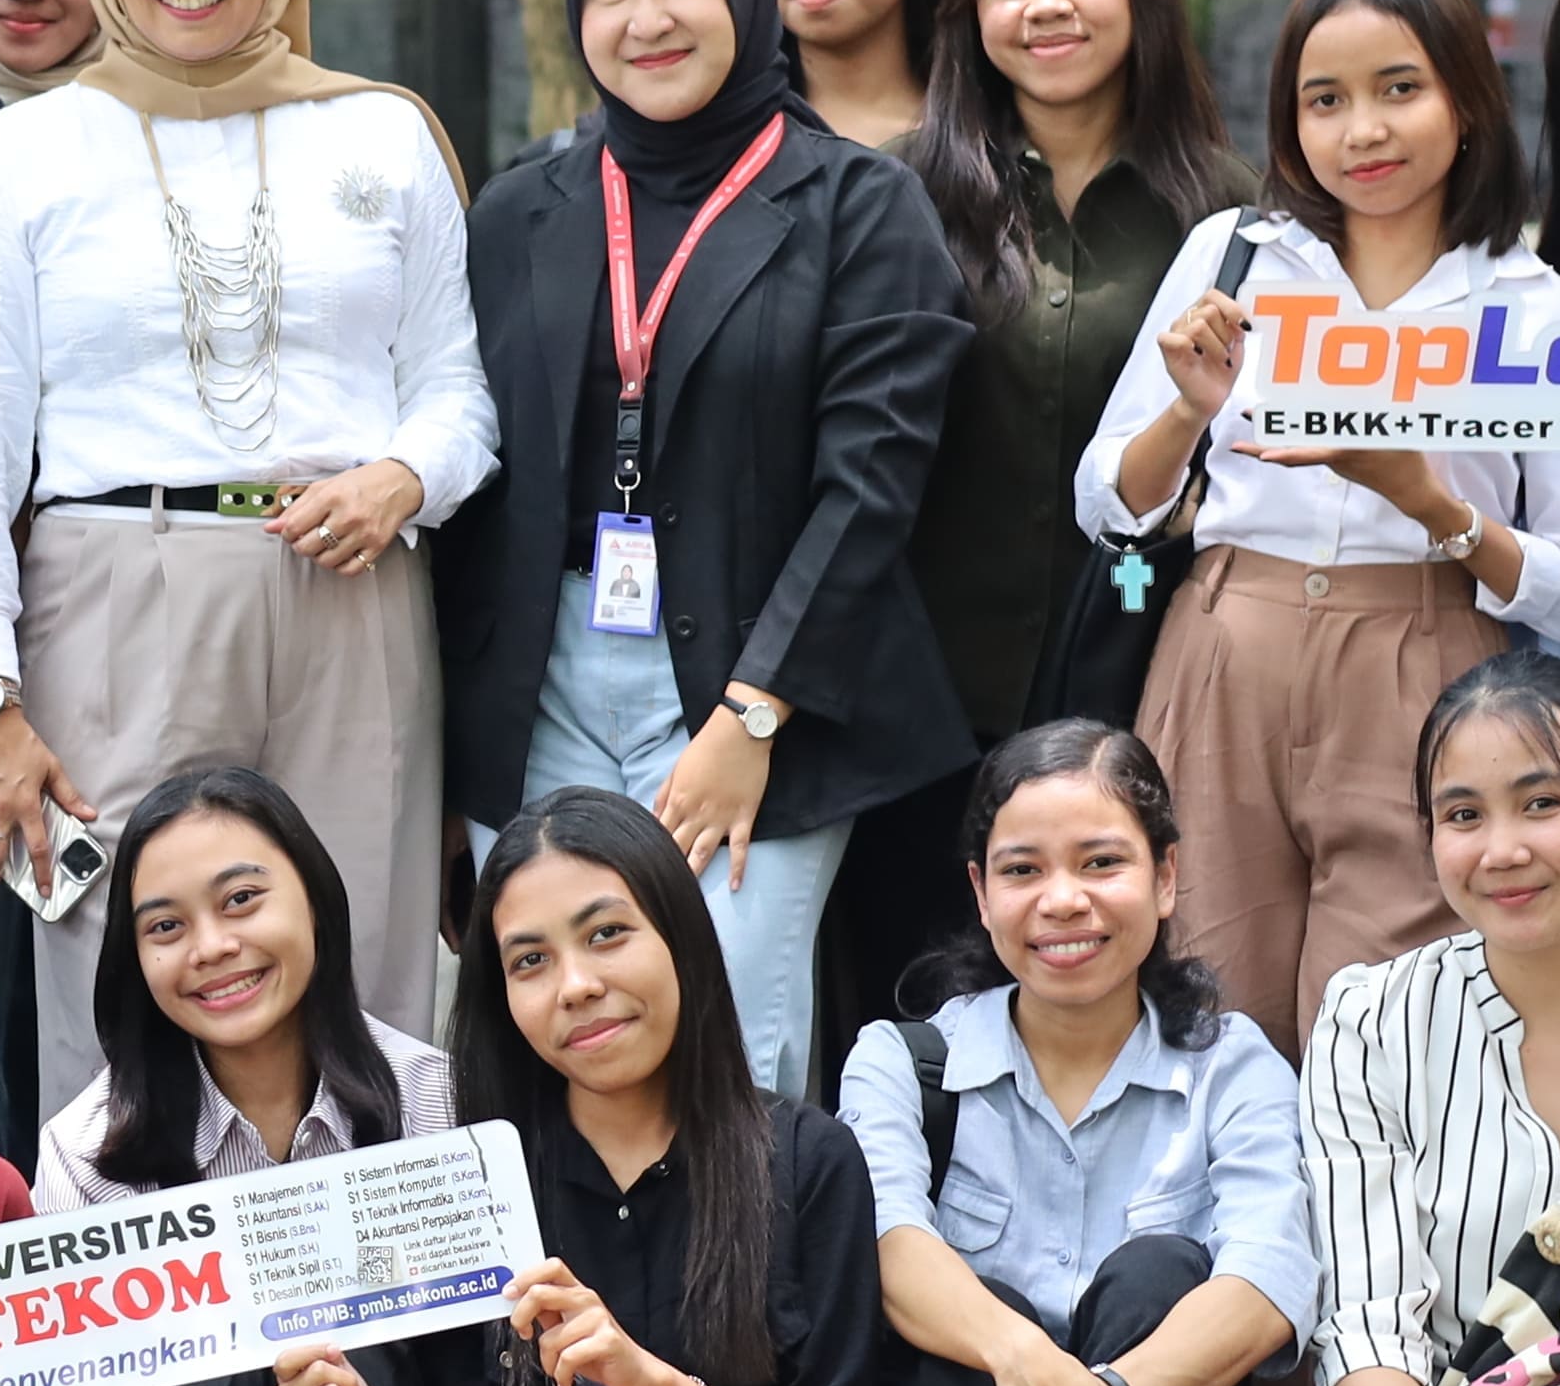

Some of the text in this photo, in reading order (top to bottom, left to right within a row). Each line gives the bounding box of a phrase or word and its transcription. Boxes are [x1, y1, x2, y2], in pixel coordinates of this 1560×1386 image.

[343, 1149, 474, 1185] S1 Sistem Informasi (S.Kom.)
[233, 1195, 246, 1209] S1
[249, 1185, 304, 1205] Manajemen
[348, 1169, 484, 1205] S1 Sistem Komputer (S.Kom.
[237, 1214, 250, 1228] S1
[253, 1205, 302, 1225] Akuntansi
[352, 1210, 365, 1224] S1
[367, 1204, 399, 1221] Teknik
[400, 1192, 454, 1215] Informatika
[241, 1233, 254, 1247] S1
[256, 1228, 288, 1244] Bisnis
[355, 1229, 369, 1244] D4
[372, 1219, 420, 1241] Akuntansi
[422, 1209, 476, 1231] Perpajakan
[403, 1239, 420, 1251] Link
[423, 1235, 447, 1247] daftar
[468, 1226, 482, 1237] VIP
[245, 1253, 258, 1266] S1
[260, 1247, 296, 1262] Hukum
[406, 1251, 427, 1264] Pasti
[429, 1247, 451, 1260] dapat
[249, 1272, 262, 1286] S1
[264, 1266, 296, 1283] Teknik
[299, 1259, 320, 1277] Sipil
[253, 1292, 266, 1305] S1
[268, 1284, 302, 1300] Desain
[304, 1276, 334, 1298] (DKV)
[277, 1273, 498, 1334] Info PMB: pmb.stekom.ac.id
[230, 1322, 238, 1350] !
